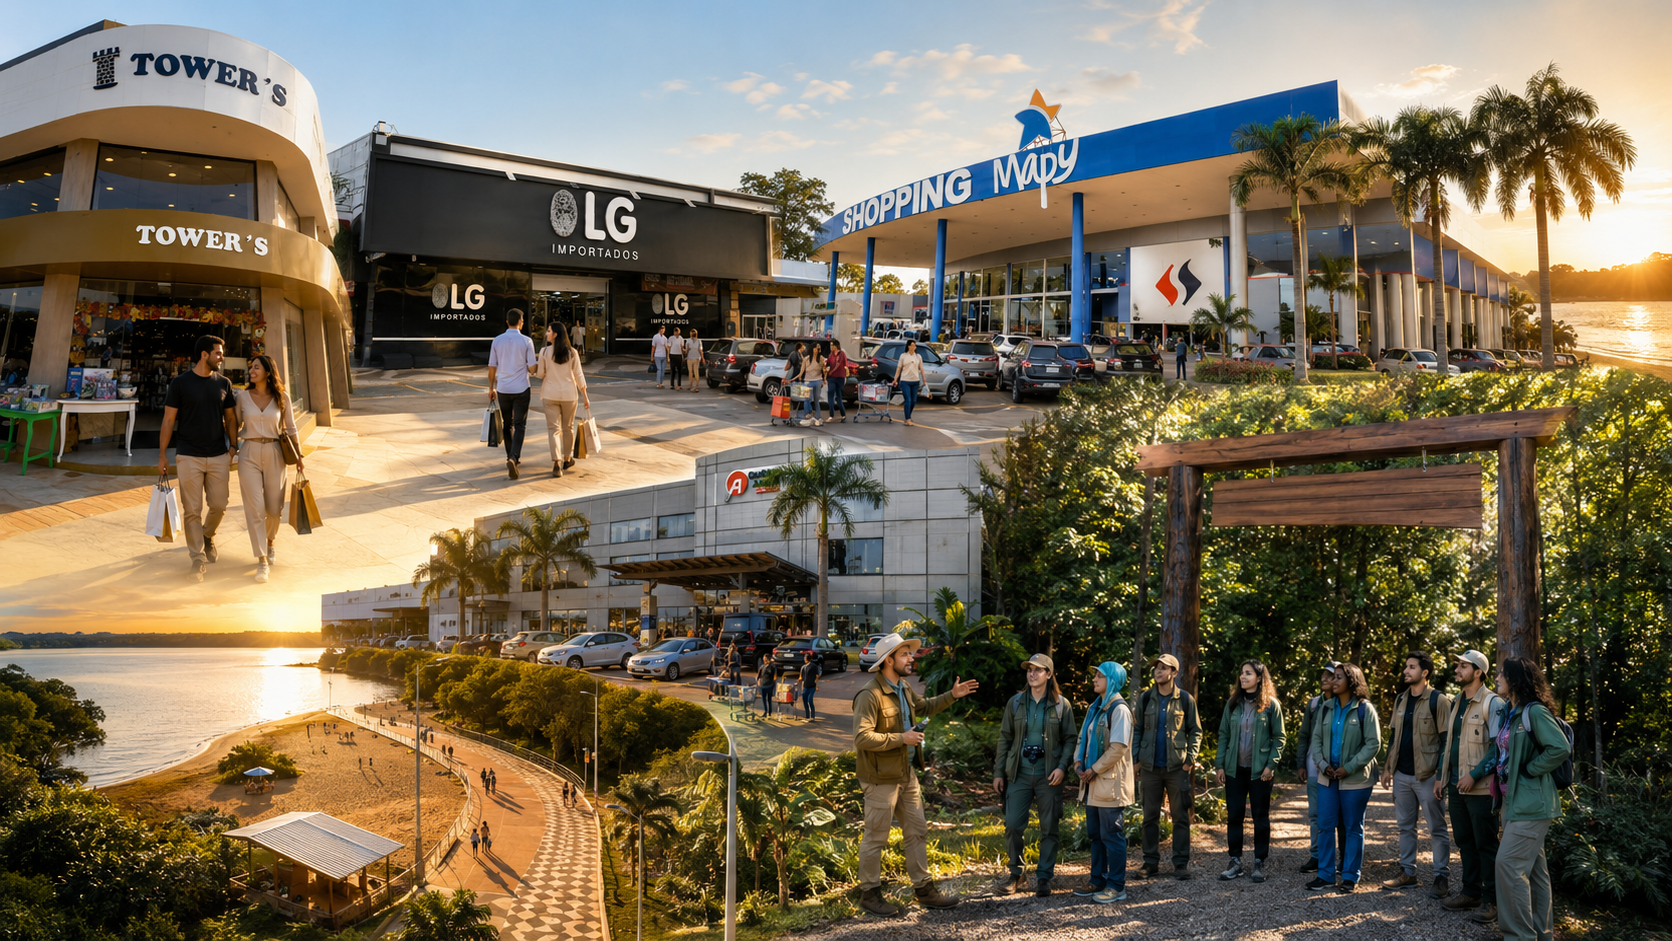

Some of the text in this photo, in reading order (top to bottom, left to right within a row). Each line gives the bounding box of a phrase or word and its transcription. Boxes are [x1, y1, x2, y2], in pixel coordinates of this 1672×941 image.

[130, 53, 287, 106] TOWER'S
[842, 138, 1079, 235] SHOPPING Mapy
[585, 191, 637, 243] LG
[136, 225, 268, 256] TOWER'S
[552, 244, 639, 260] IMPORTADOS
[451, 283, 485, 310] LG
[664, 293, 689, 315] LG
[430, 313, 486, 321] IMPORTADOS
